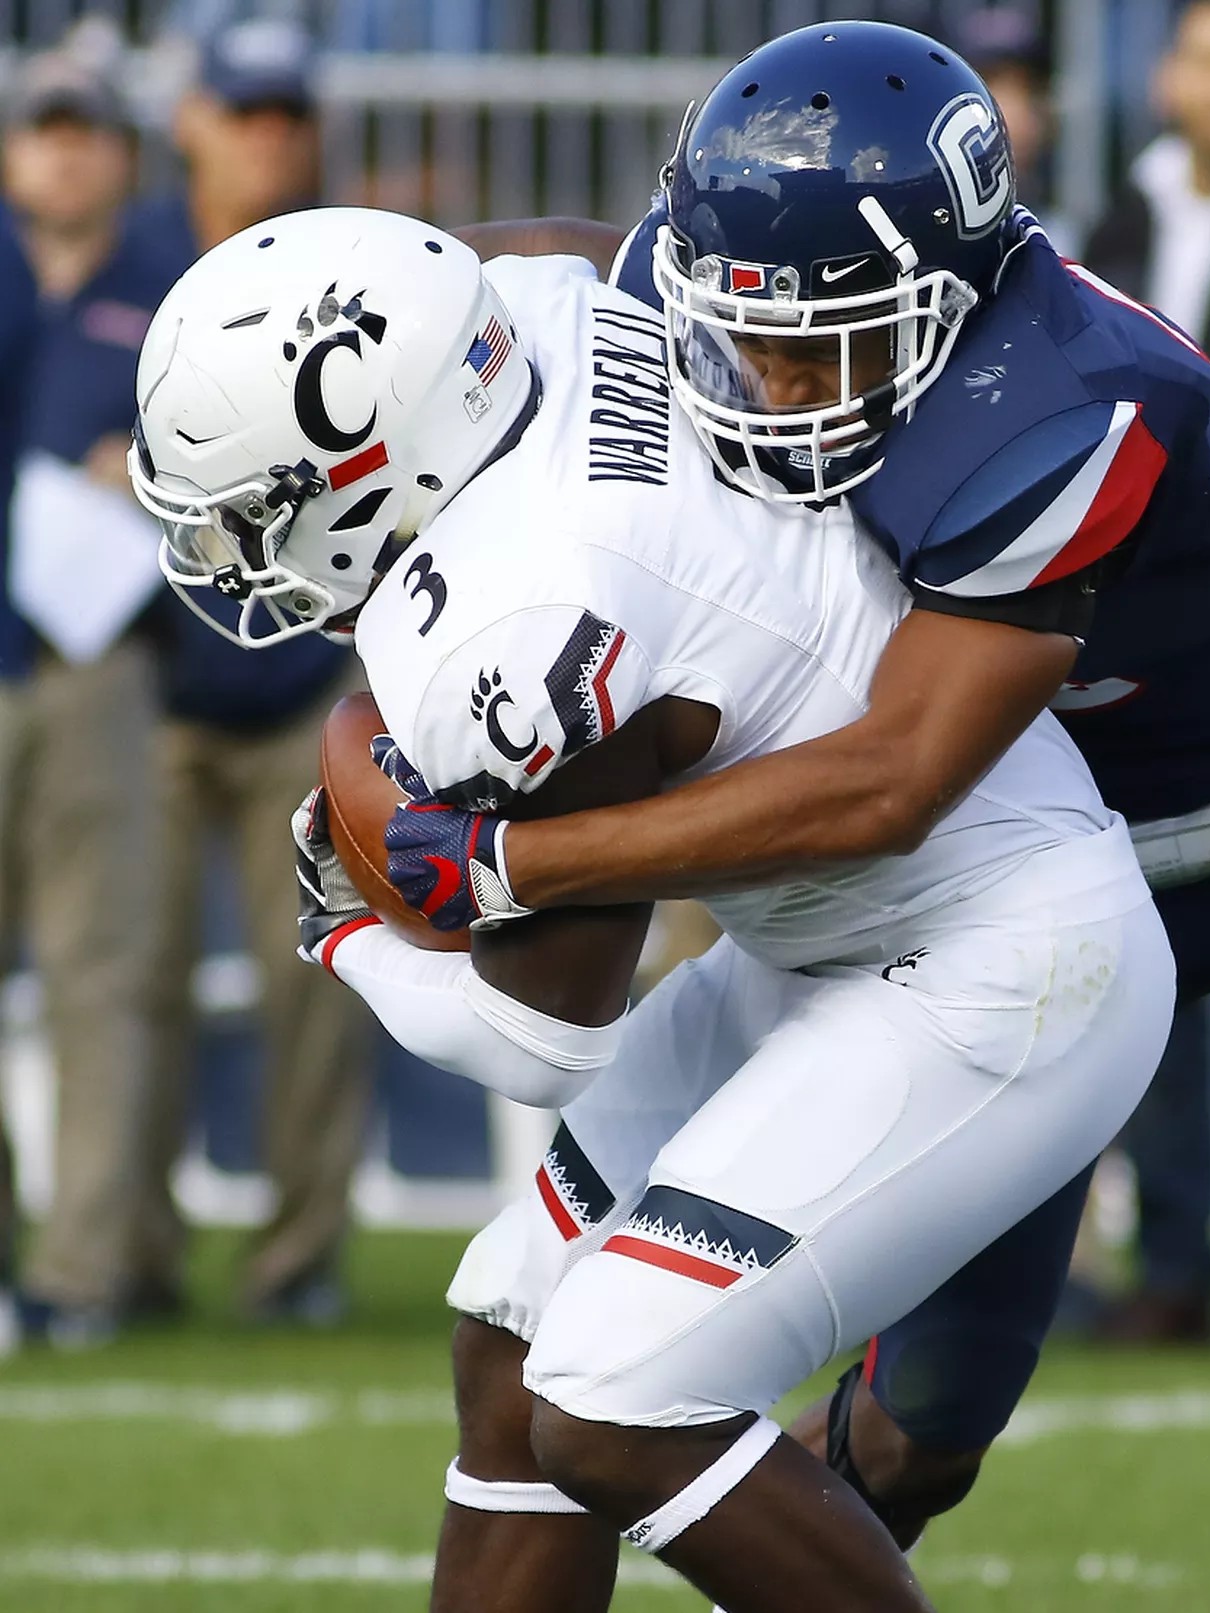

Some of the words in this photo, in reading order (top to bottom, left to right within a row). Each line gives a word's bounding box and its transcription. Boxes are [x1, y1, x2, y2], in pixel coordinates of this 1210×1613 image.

[926, 92, 1012, 241] C
[294, 330, 378, 452] C
[588, 335, 669, 486] WARREN
[403, 552, 447, 637] 3
[486, 689, 540, 763] C
